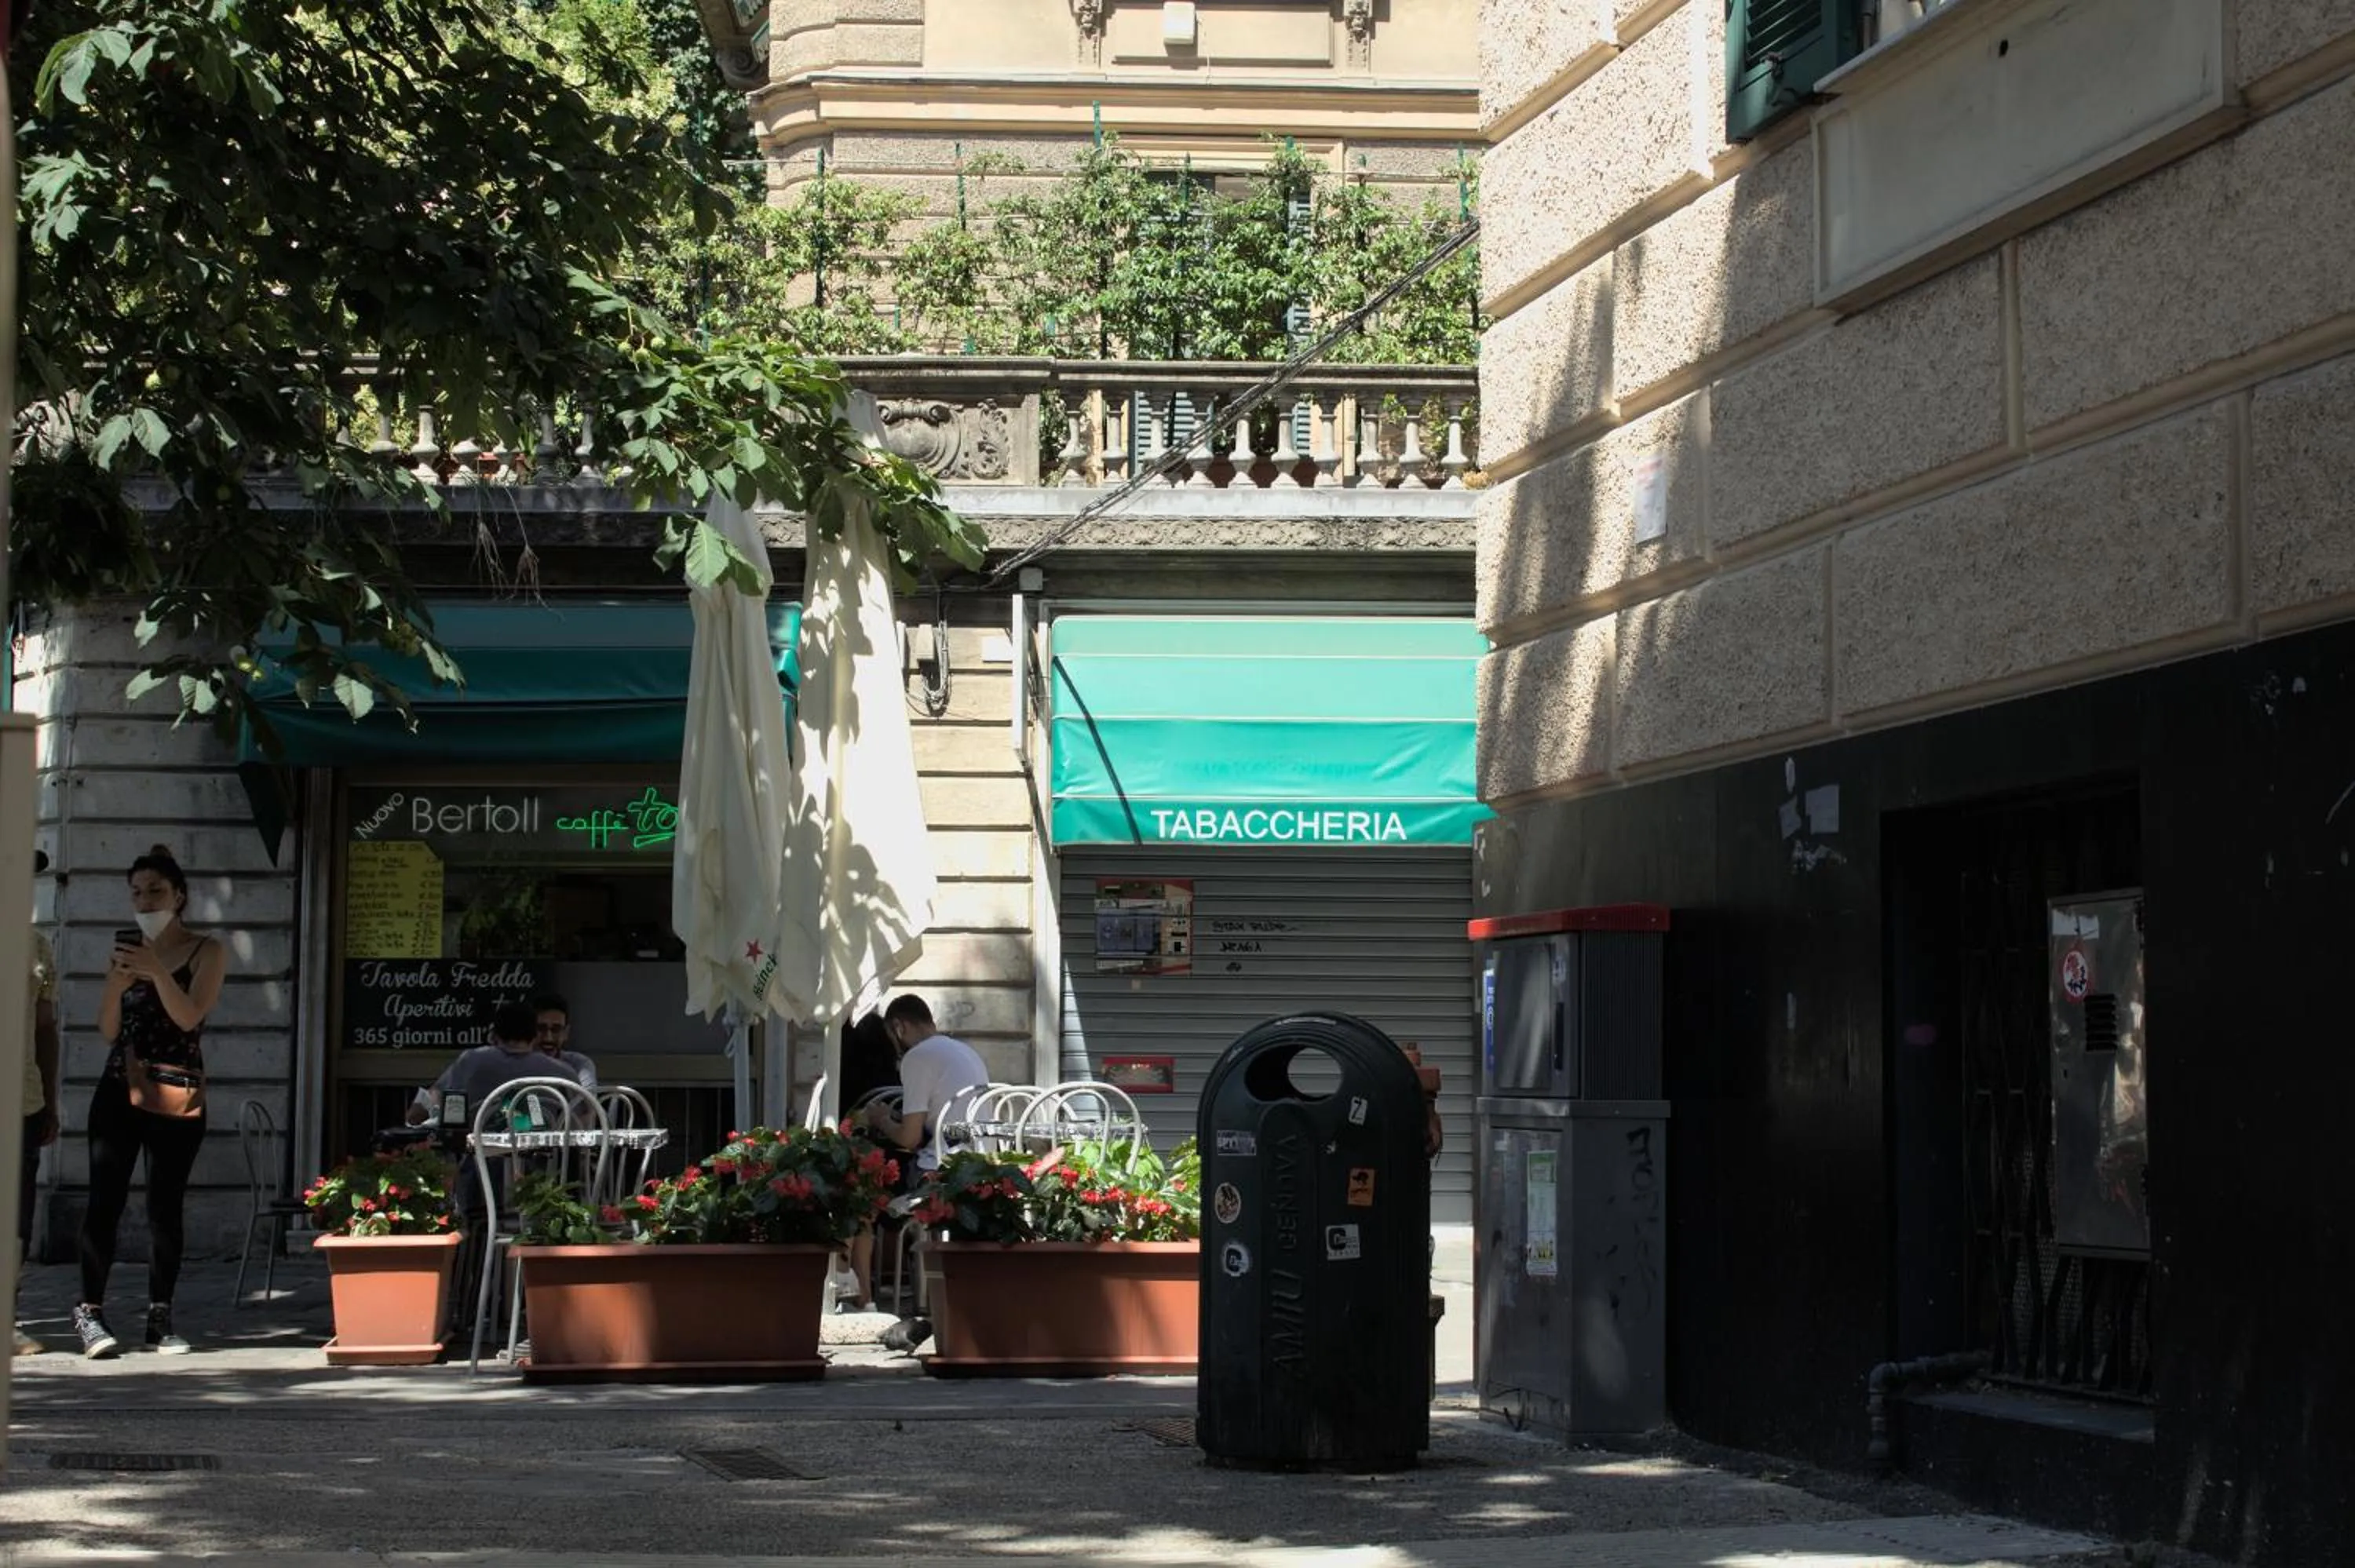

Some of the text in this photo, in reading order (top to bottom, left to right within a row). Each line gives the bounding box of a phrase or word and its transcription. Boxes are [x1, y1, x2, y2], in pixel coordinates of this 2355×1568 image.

[1151, 809, 1407, 841] TABACCHERIA
[360, 961, 536, 989] Tavola Fredda
[384, 993, 474, 1027] Aperitivi
[354, 1026, 388, 1045] 365
[392, 1026, 453, 1048] giorni
